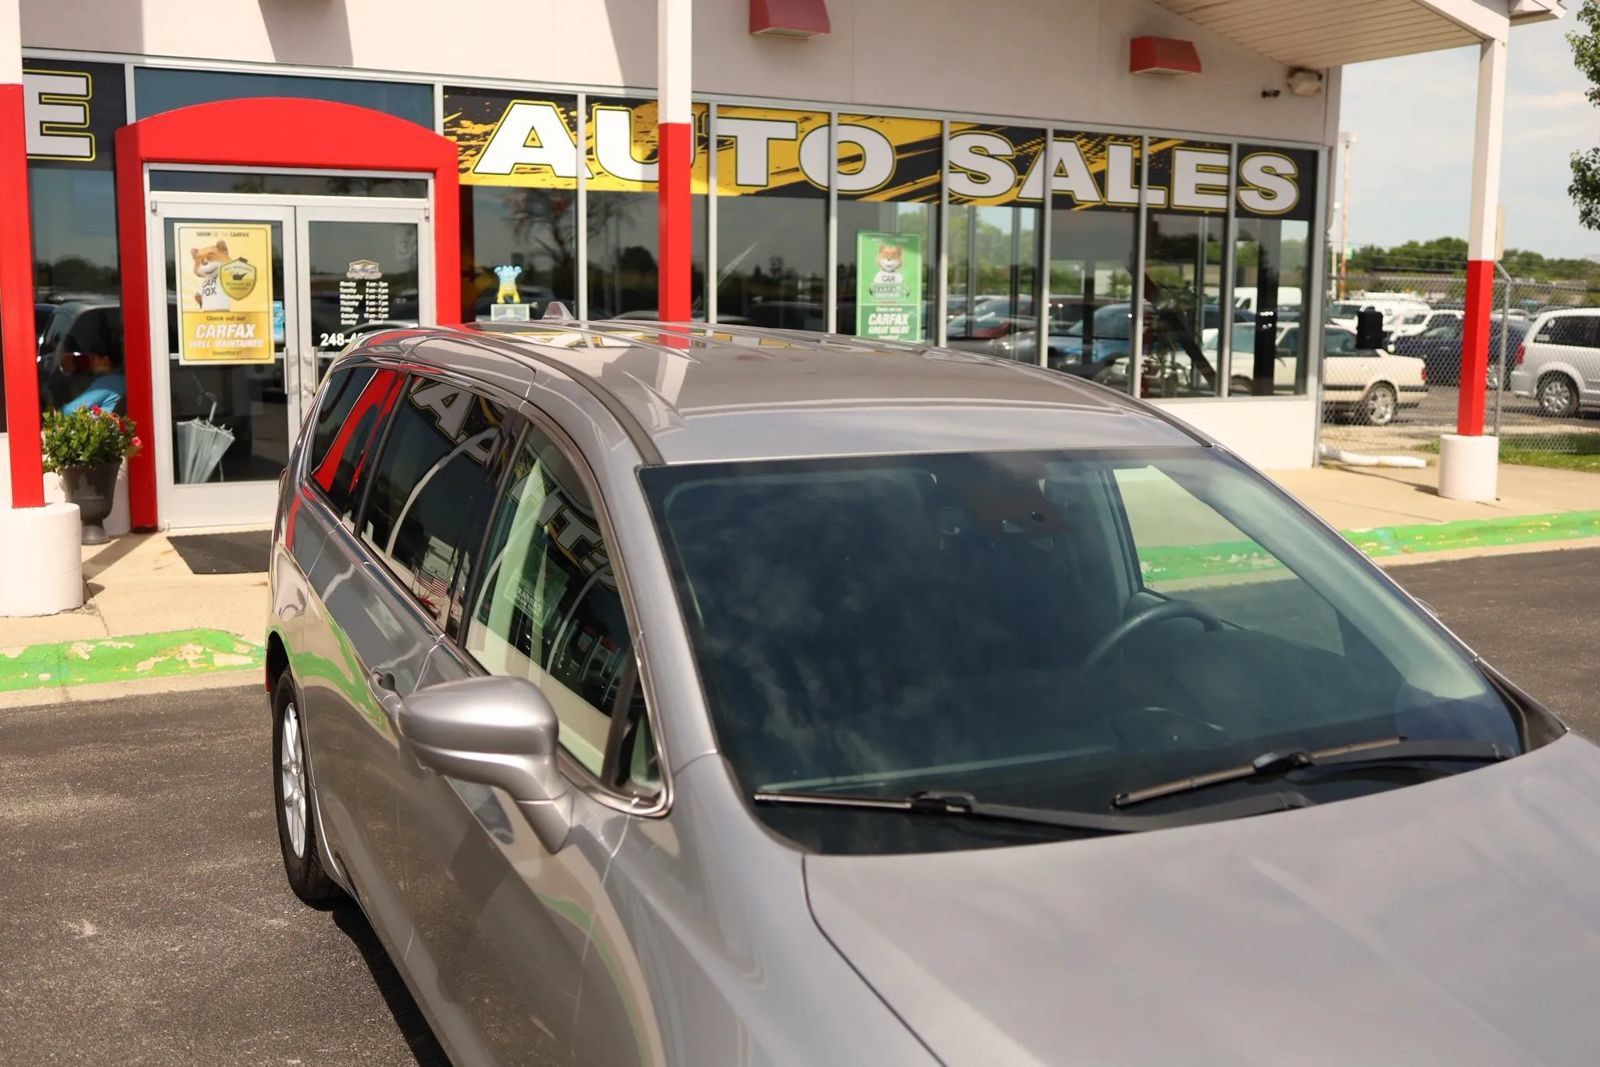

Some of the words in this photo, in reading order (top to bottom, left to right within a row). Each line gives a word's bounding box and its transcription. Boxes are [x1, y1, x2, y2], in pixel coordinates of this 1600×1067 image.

[472, 99, 897, 194] AUTO
[948, 130, 1300, 214] SALES
[868, 313, 909, 325] CARFAX
[196, 324, 255, 338] CARFAX
[320, 332, 363, 347] 248-4
